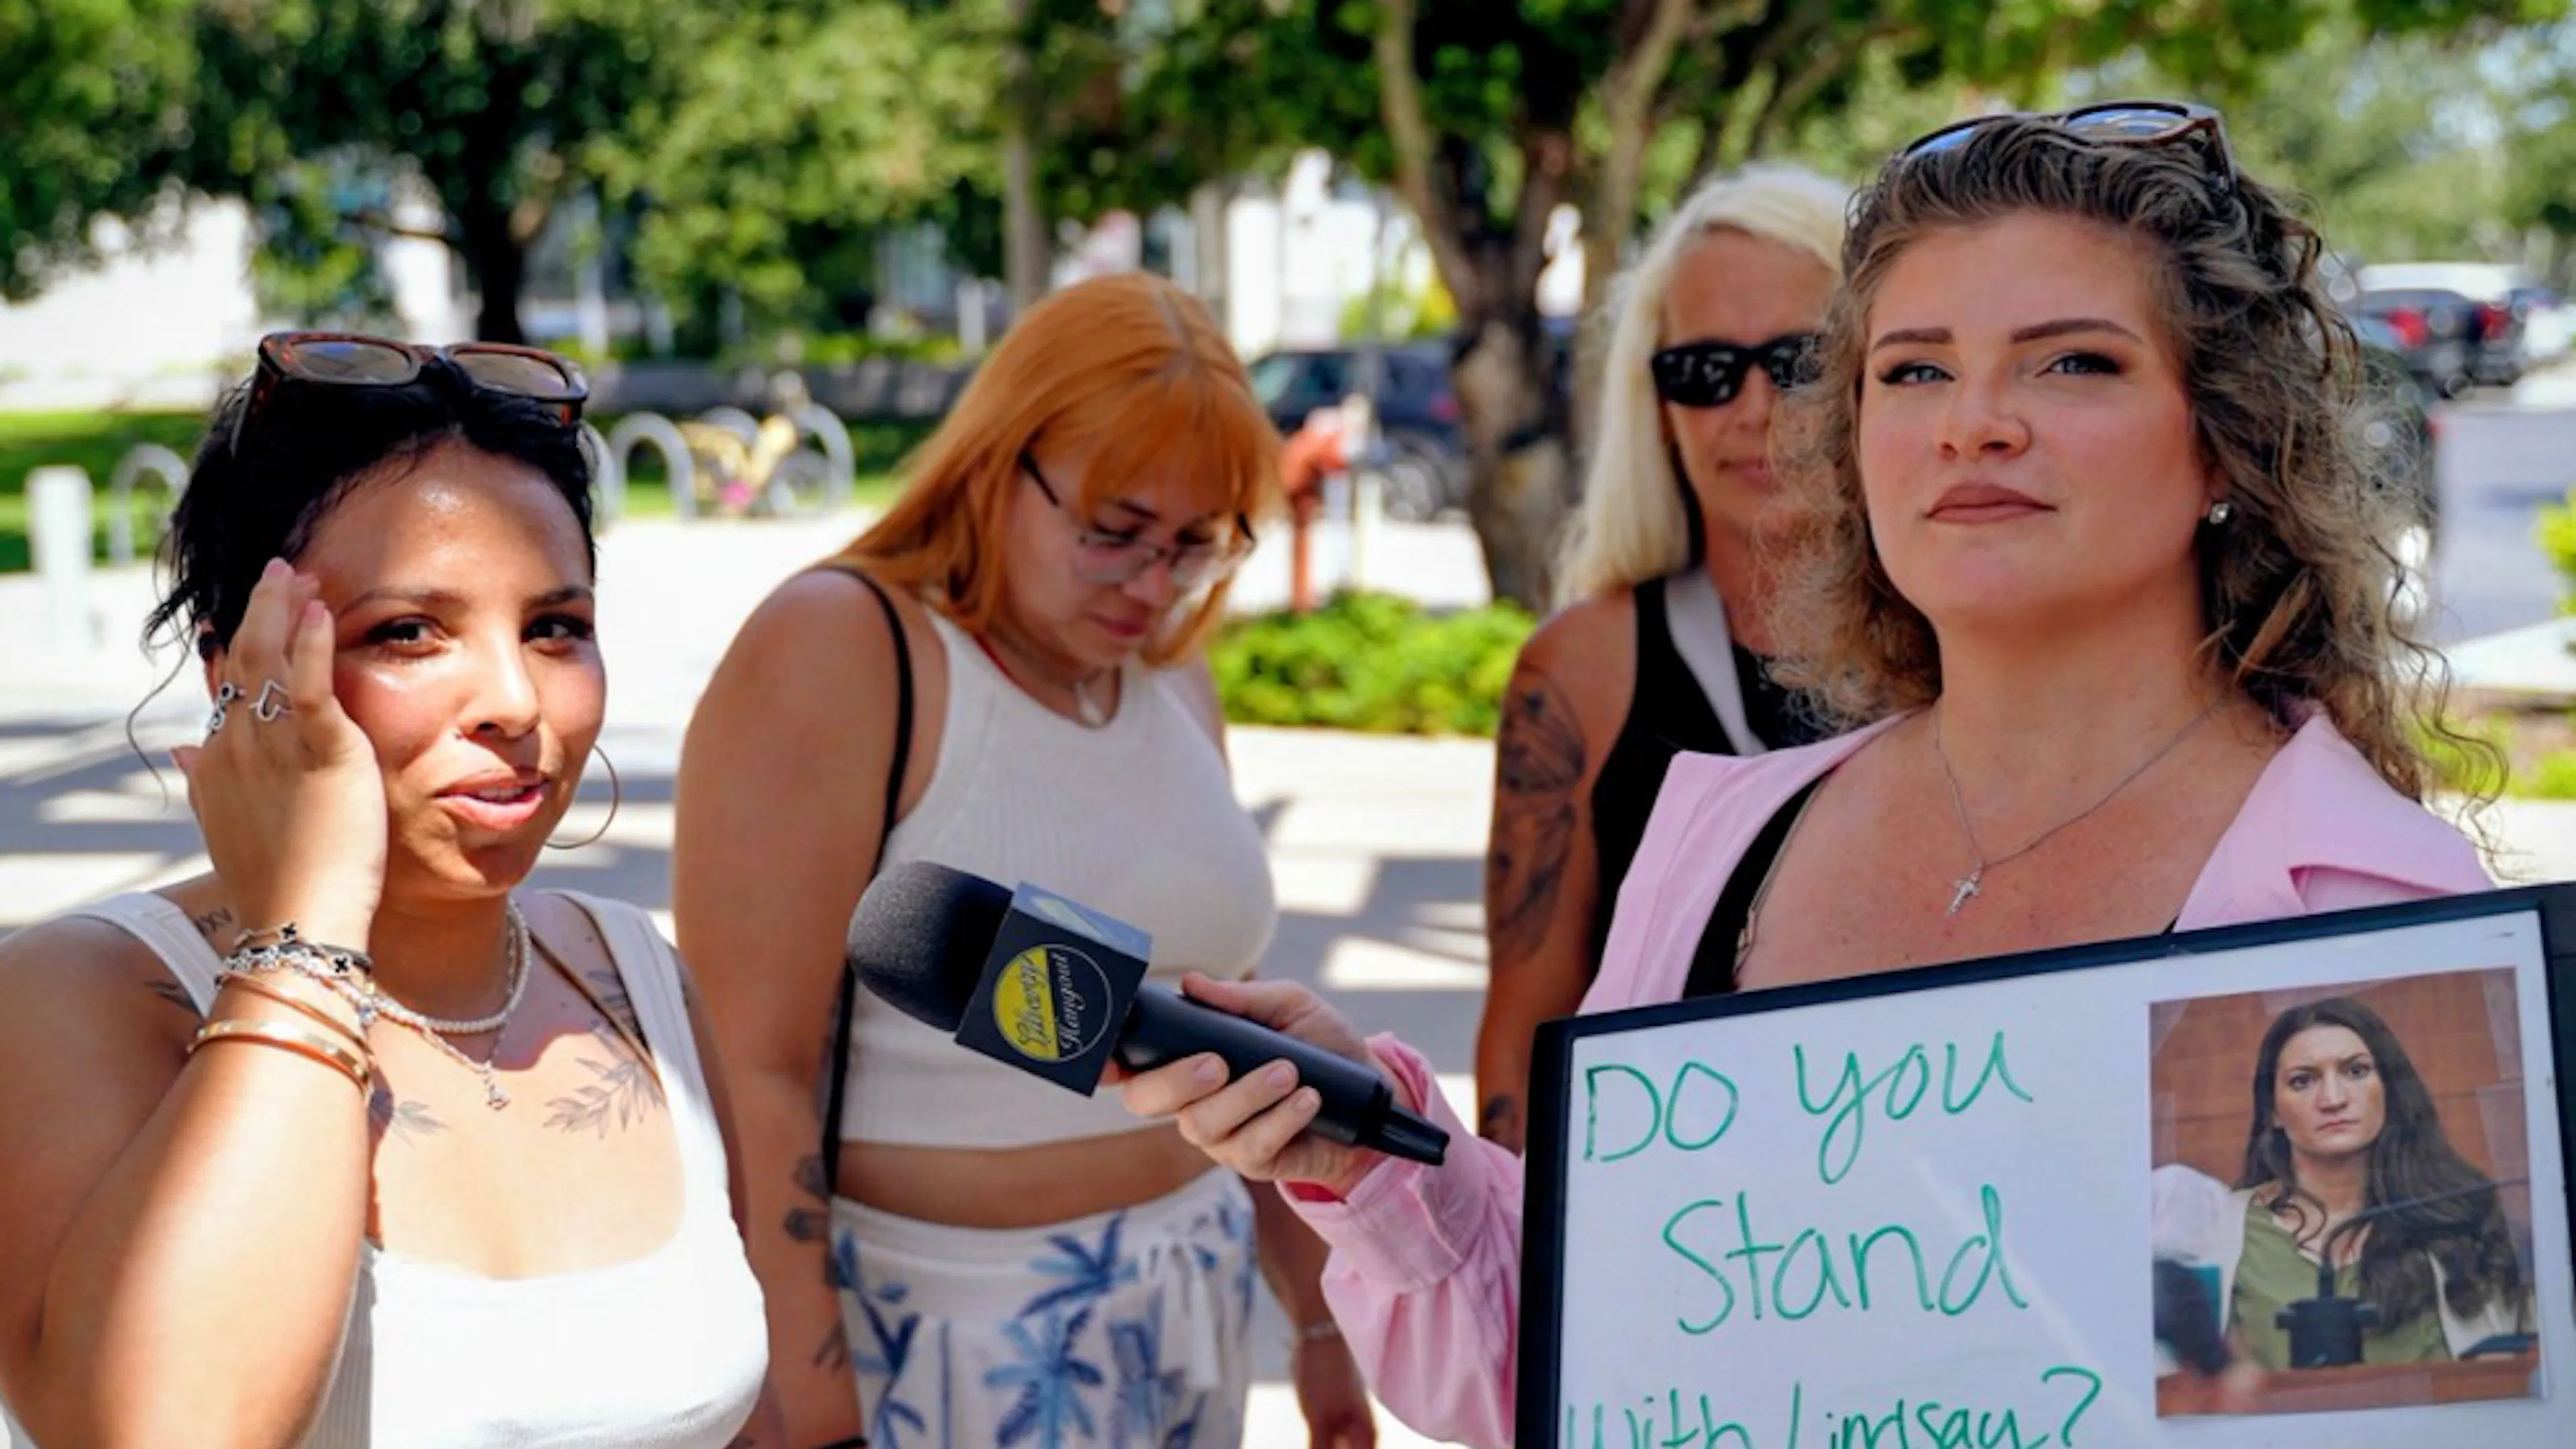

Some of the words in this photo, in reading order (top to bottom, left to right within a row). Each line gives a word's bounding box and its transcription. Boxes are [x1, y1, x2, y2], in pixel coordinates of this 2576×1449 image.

[1016, 954, 1051, 1047] Liberty
[1051, 951, 1085, 1051] Hangout
[1662, 1183, 2028, 1334] Stand
